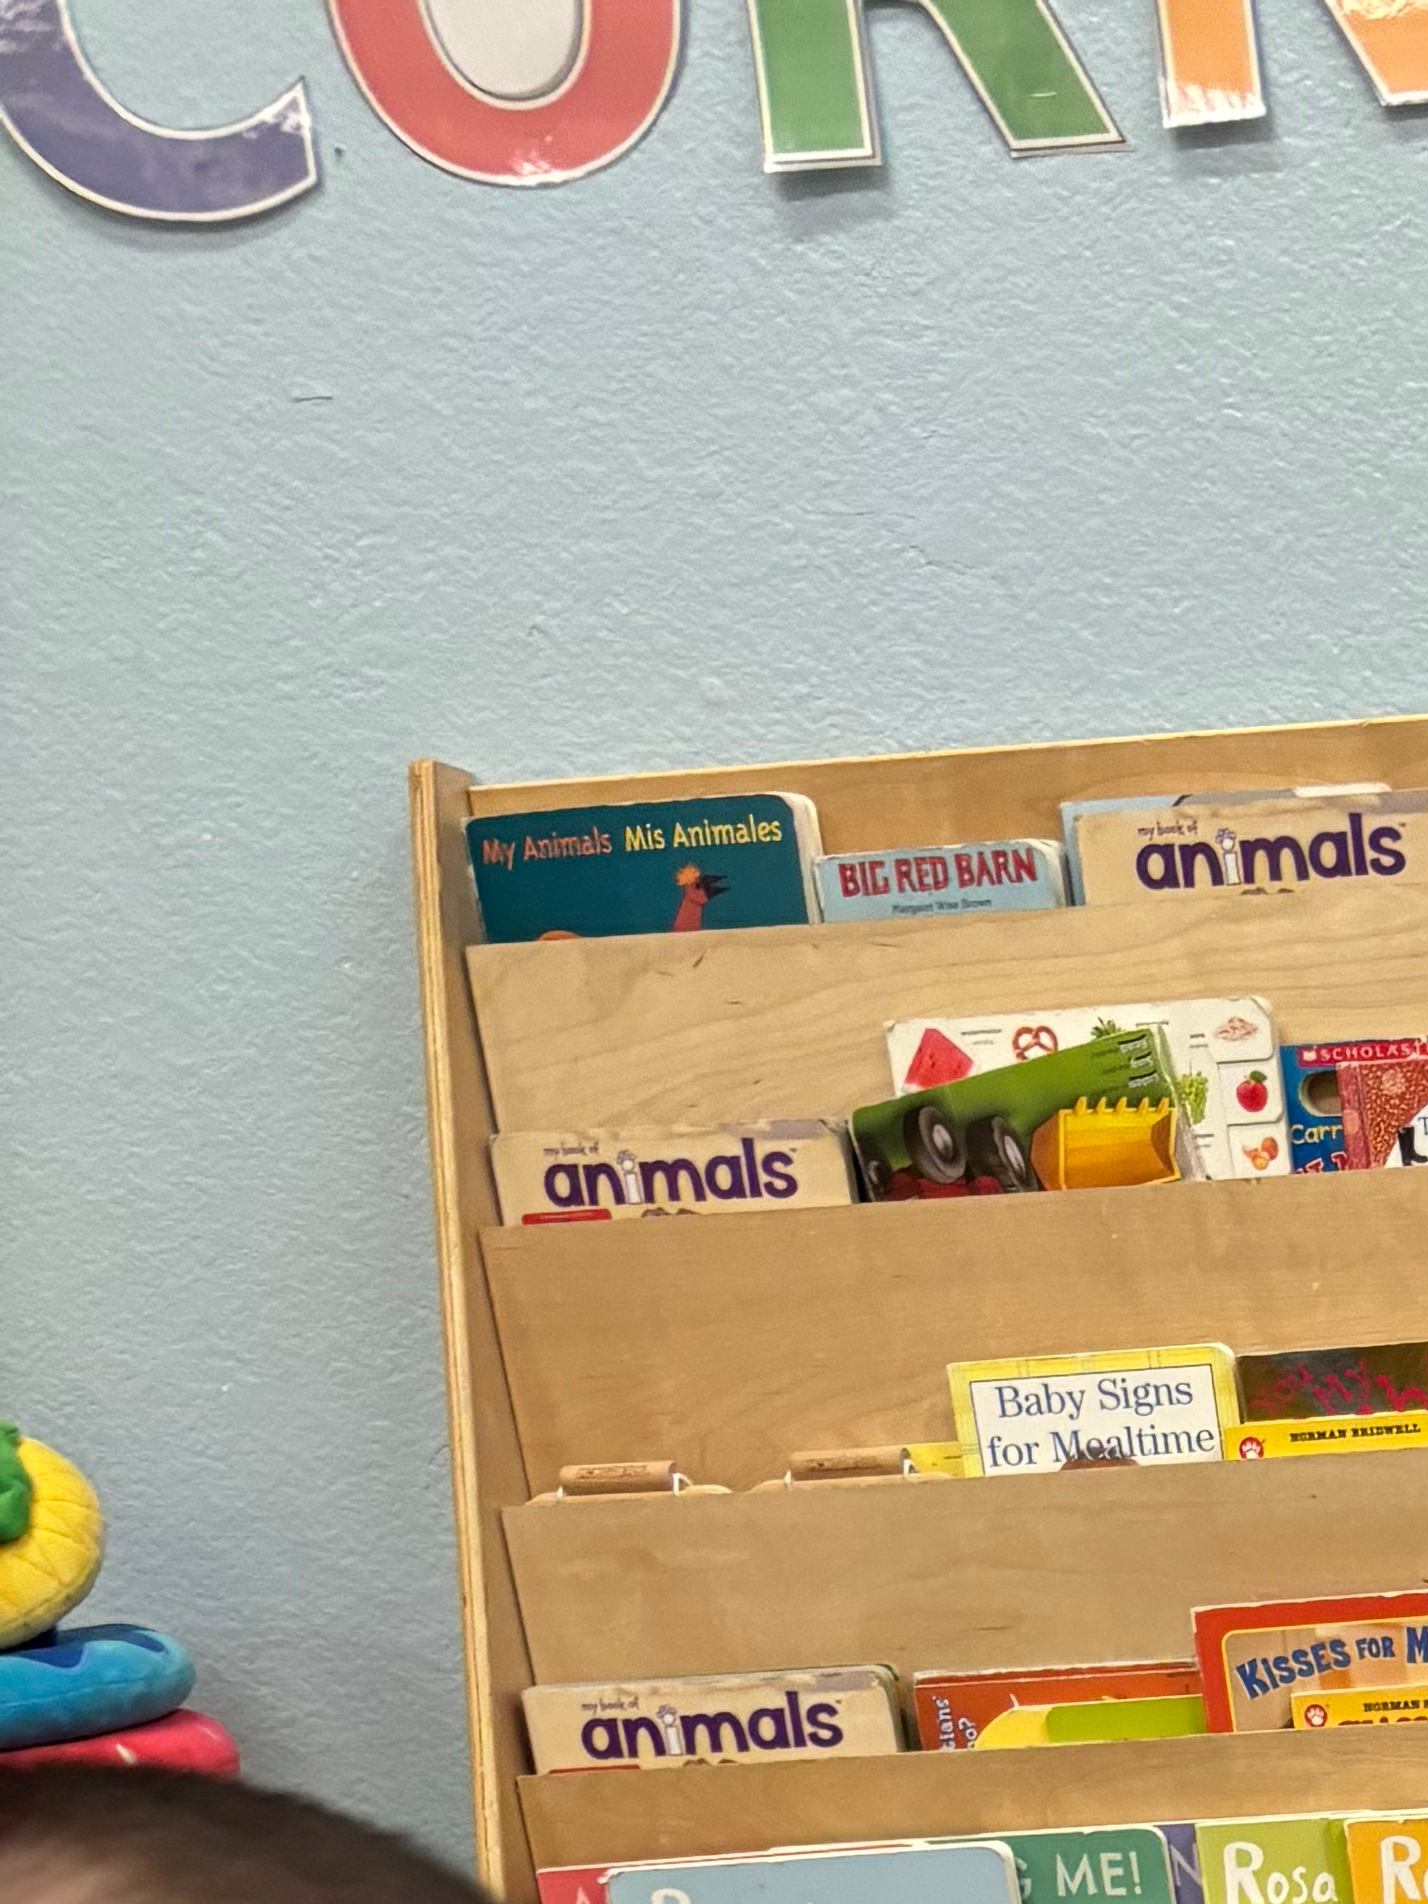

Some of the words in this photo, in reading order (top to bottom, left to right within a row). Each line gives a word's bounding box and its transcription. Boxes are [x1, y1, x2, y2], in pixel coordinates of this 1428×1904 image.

[482, 838, 516, 870] My
[523, 825, 612, 861] Animals
[623, 823, 666, 852] Mis
[672, 814, 782, 848] Animales
[1136, 812, 1406, 890] animals
[1157, 821, 1184, 837] book
[838, 860, 891, 898] BIG
[894, 855, 949, 893] RED
[954, 847, 1038, 888] BARN
[1290, 1123, 1343, 1145] Carr
[543, 1137, 799, 1208] animals
[994, 1382, 1086, 1421] Baby
[1097, 1376, 1194, 1416] Signs
[987, 1435, 1040, 1468] for
[1048, 1423, 1217, 1464] Mealtime
[1351, 1424, 1422, 1439] BRIDWELL
[1236, 1637, 1351, 1700] KISSES
[1355, 1636, 1396, 1660] FOR
[581, 1690, 843, 1760] animals
[1056, 1850, 1143, 1898] ME!
